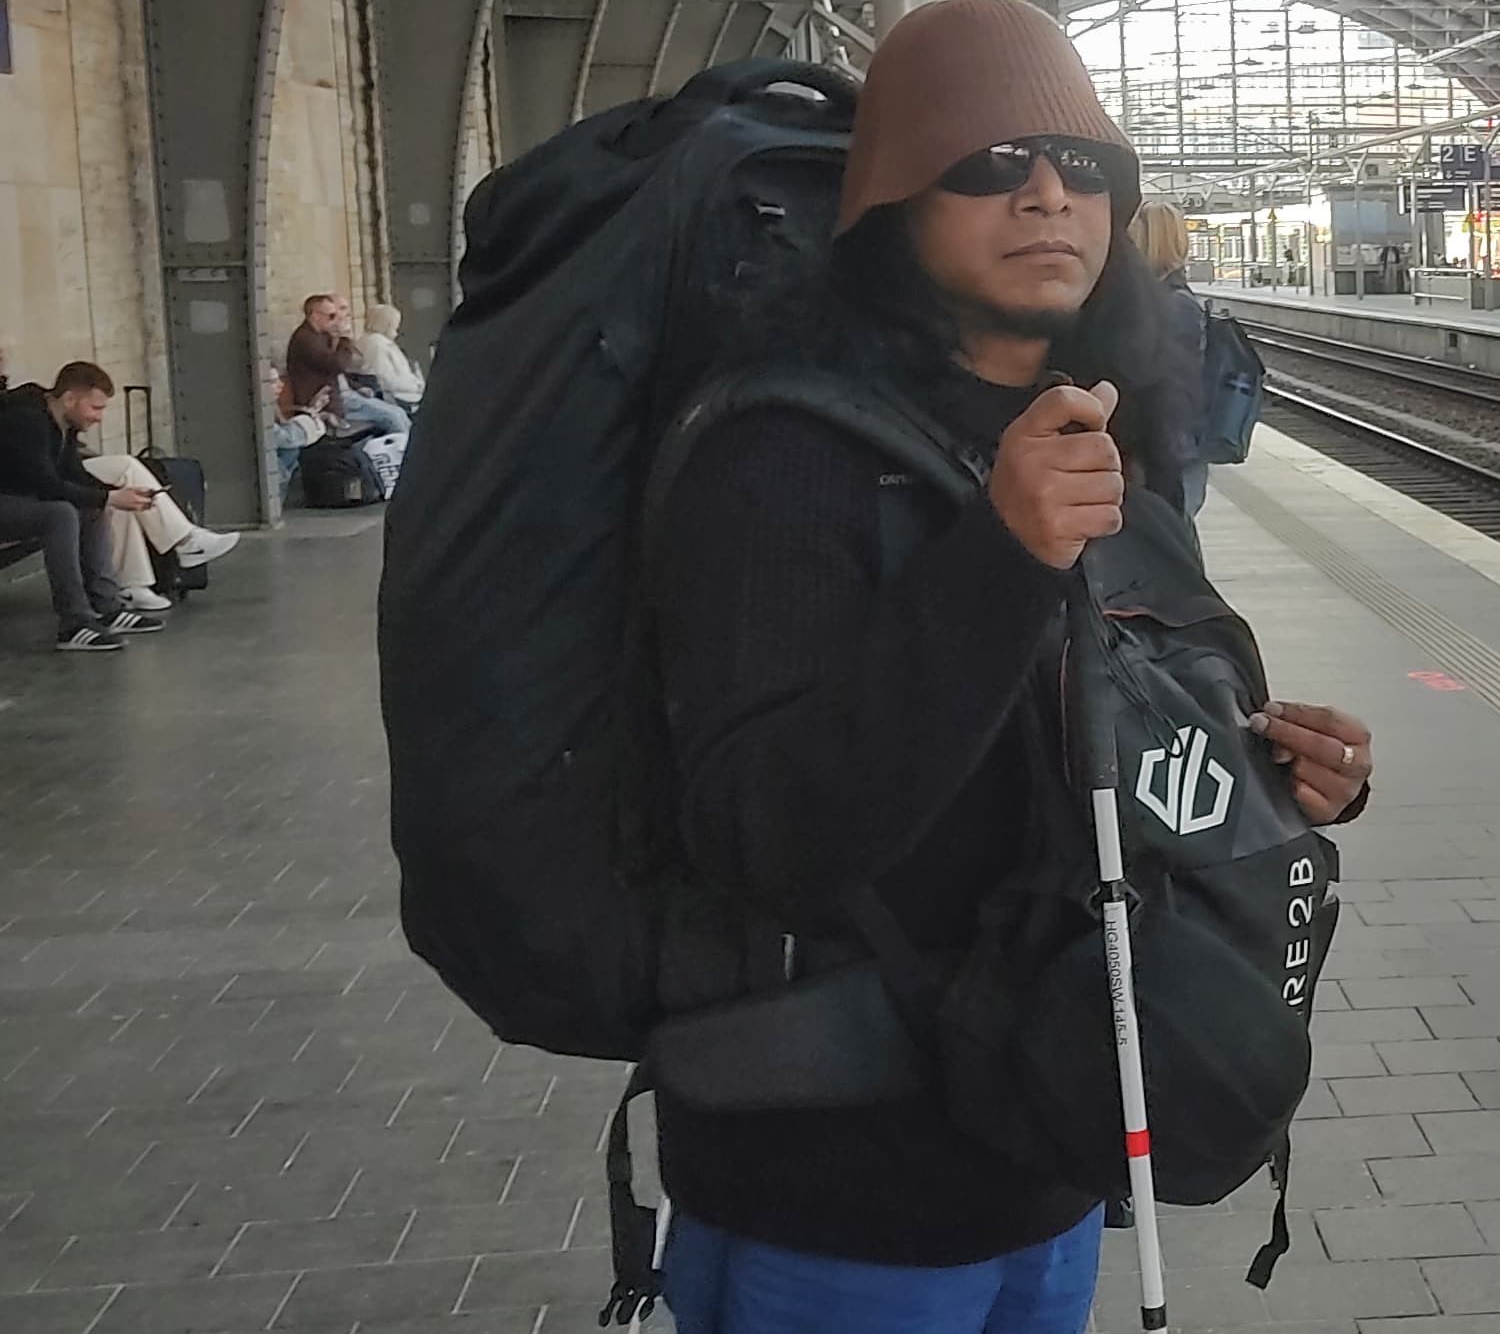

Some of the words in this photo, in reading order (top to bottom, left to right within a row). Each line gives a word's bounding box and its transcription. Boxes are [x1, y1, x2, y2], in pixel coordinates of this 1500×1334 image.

[1442, 146, 1454, 162] 2
[1464, 146, 1477, 162] E
[1283, 857, 1314, 1015] RE2B
